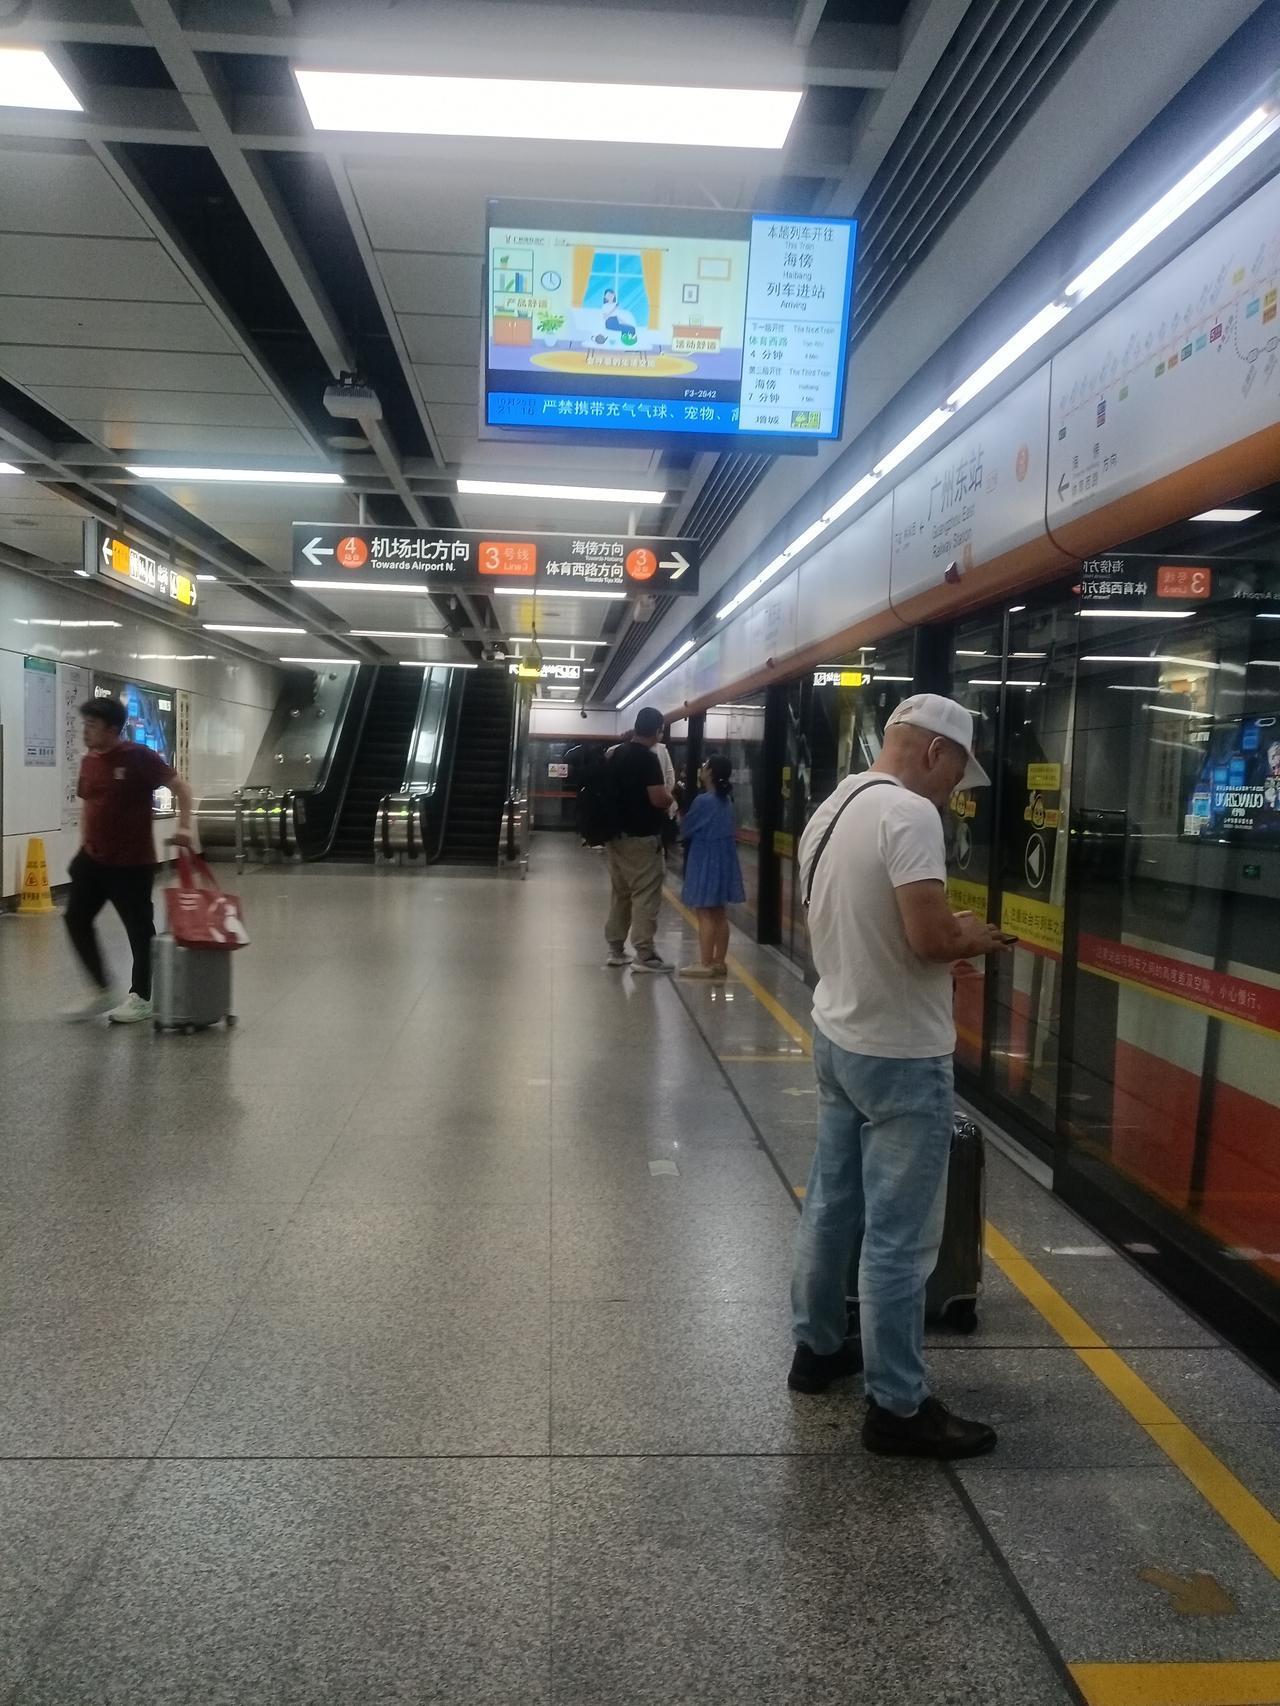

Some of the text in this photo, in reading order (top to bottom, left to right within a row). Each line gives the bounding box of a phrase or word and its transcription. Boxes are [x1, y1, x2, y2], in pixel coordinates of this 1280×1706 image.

[768, 224, 834, 241] 本趟列车开往
[783, 252, 814, 268] 海傍
[767, 282, 825, 299] 列车进站
[762, 350, 783, 360] 分钟
[759, 393, 780, 403] 分钟
[927, 443, 984, 522] 广州东站
[344, 537, 357, 554] 4
[371, 537, 470, 561] 机场北方向
[572, 540, 624, 557] 海傍方向
[371, 559, 410, 570] Towards
[411, 560, 444, 572] Airport
[445, 562, 456, 571] N.
[486, 547, 500, 569] 3
[635, 549, 648, 566] 3
[545, 560, 624, 578] 体育西路方向
